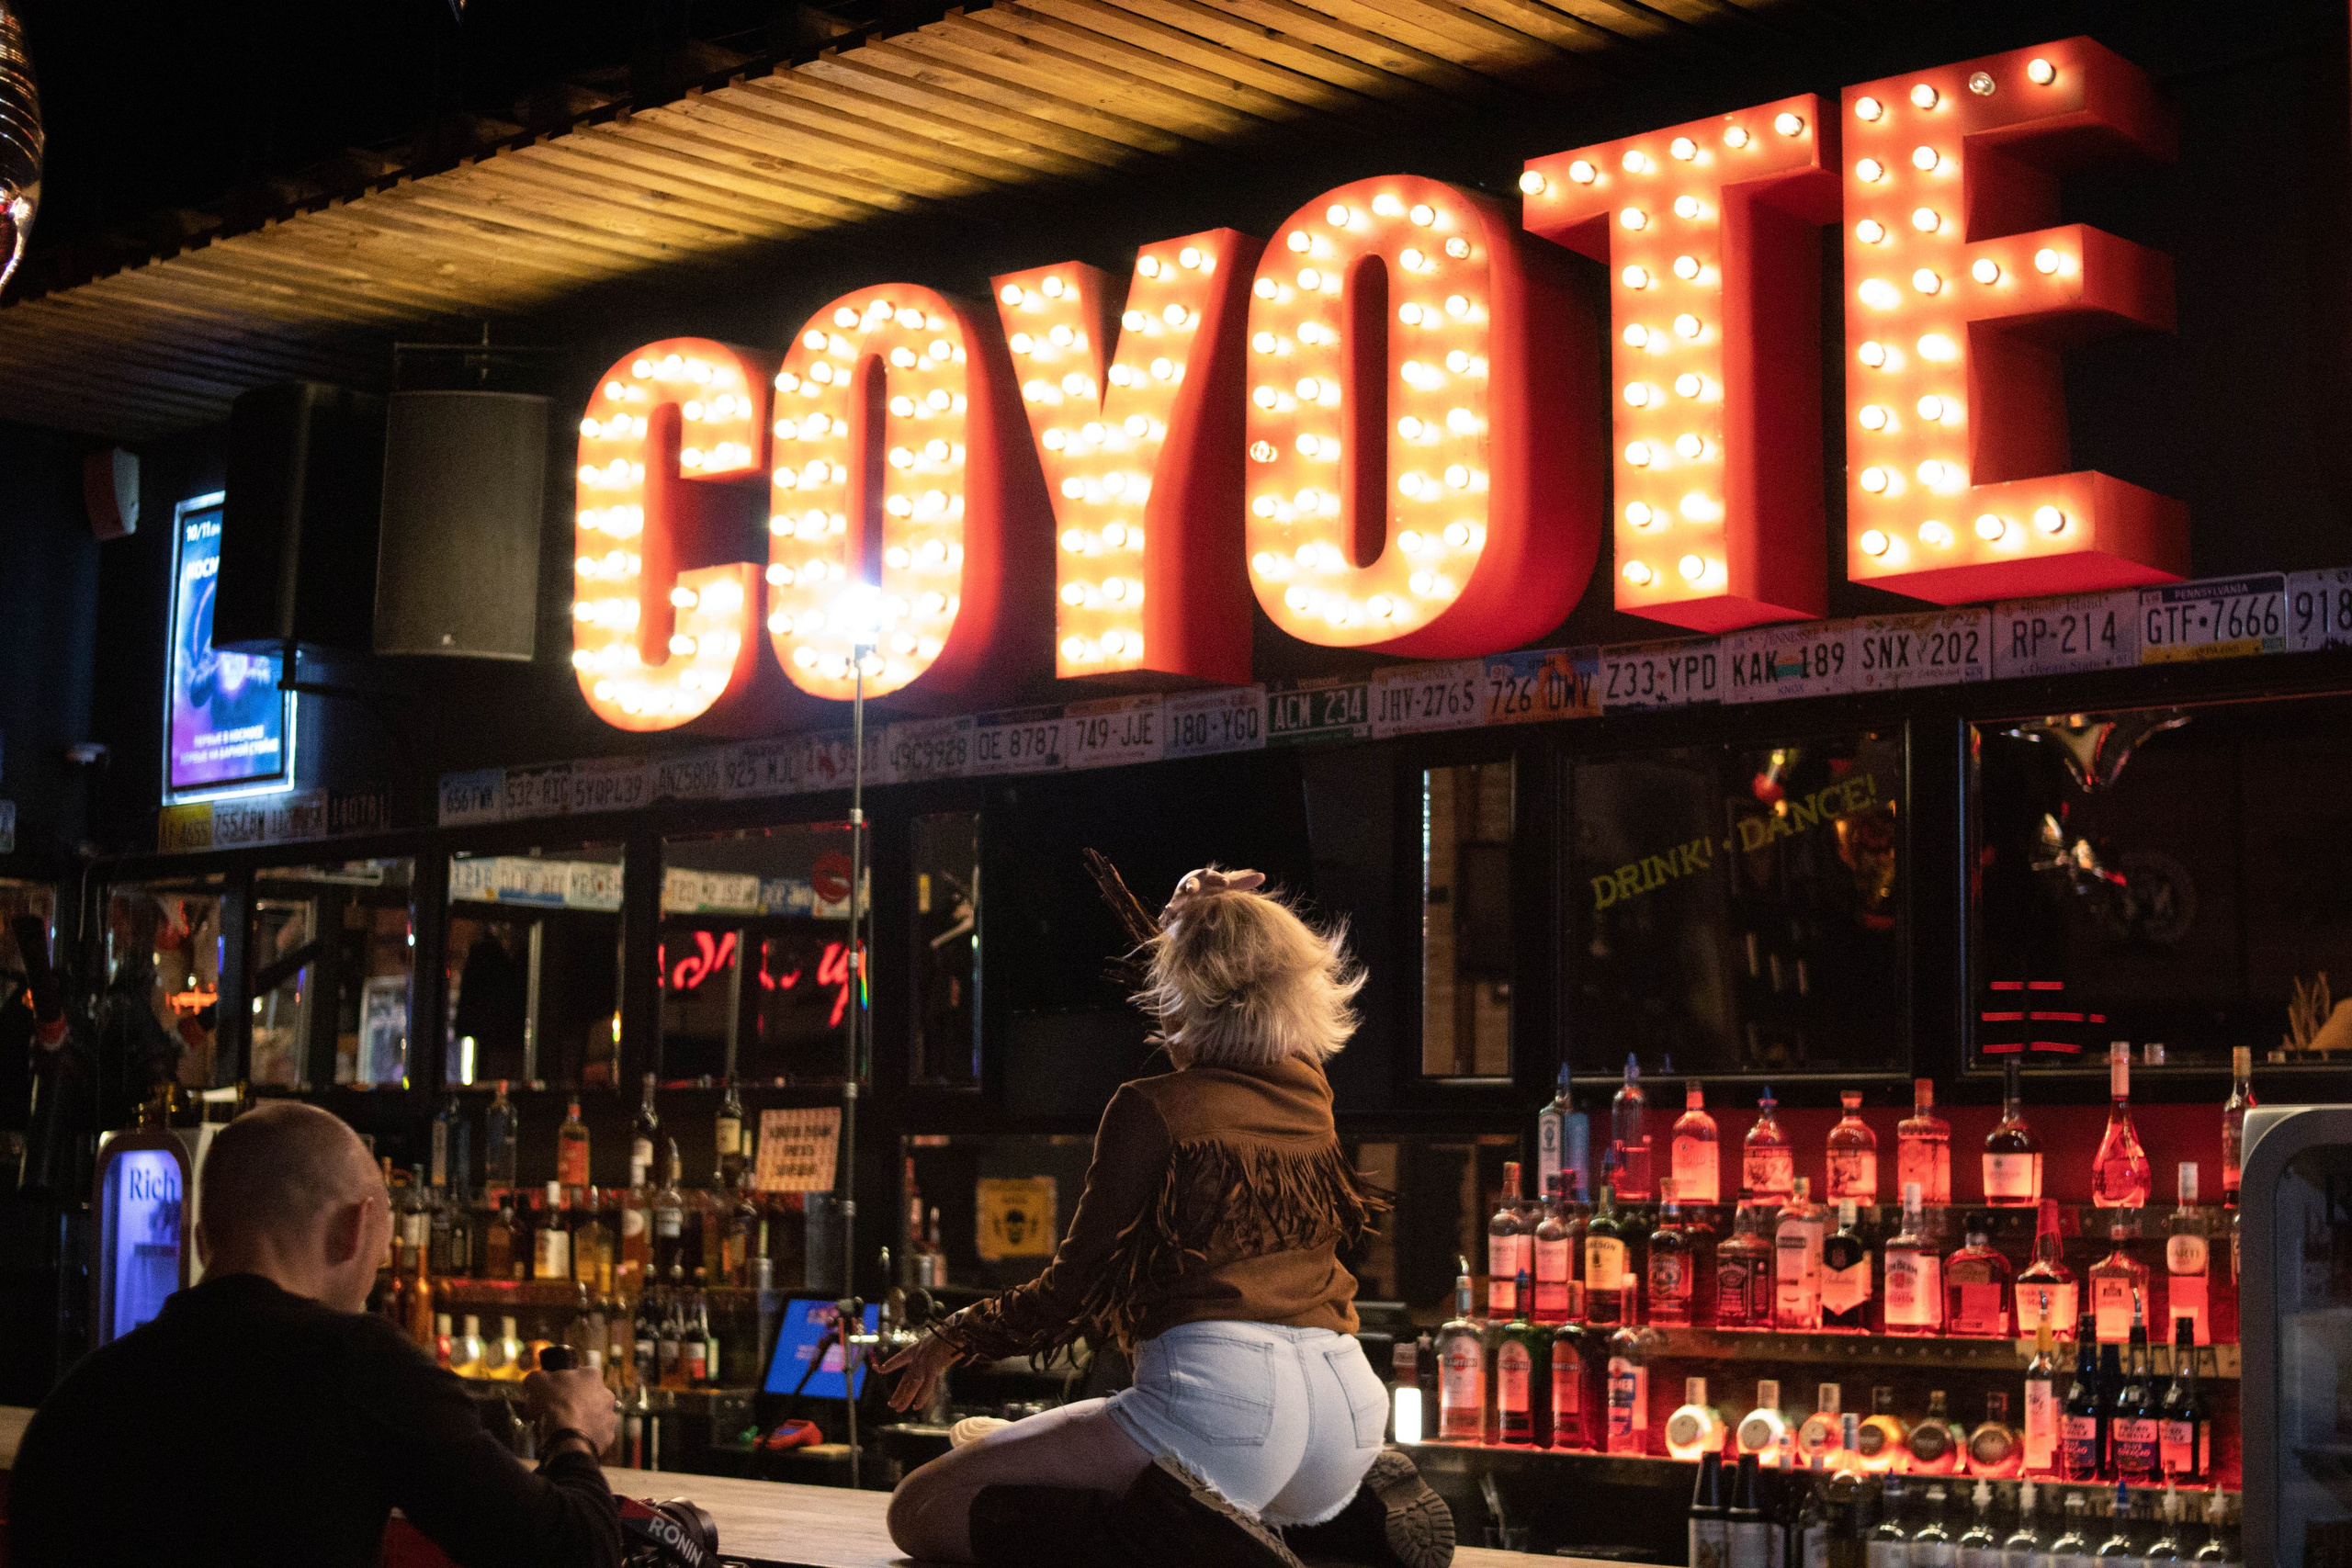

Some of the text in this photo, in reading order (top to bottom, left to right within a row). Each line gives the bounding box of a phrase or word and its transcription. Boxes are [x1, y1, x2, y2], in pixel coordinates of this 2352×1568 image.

[568, 35, 2188, 733] COYOTE
[2175, 582, 2249, 600] PENNSYLVANIA
[1861, 630, 1979, 670] SNX 202
[2012, 611, 2116, 659] RP-214
[1733, 642, 1845, 687] KAK 189
[1324, 689, 1363, 724] 234
[1490, 677, 1532, 715] 726
[1010, 725, 1060, 758] 8787
[1590, 773, 1878, 910] DRINK! DANCE!
[130, 1168, 175, 1201] Rich
[648, 1516, 703, 1567] RONIN
